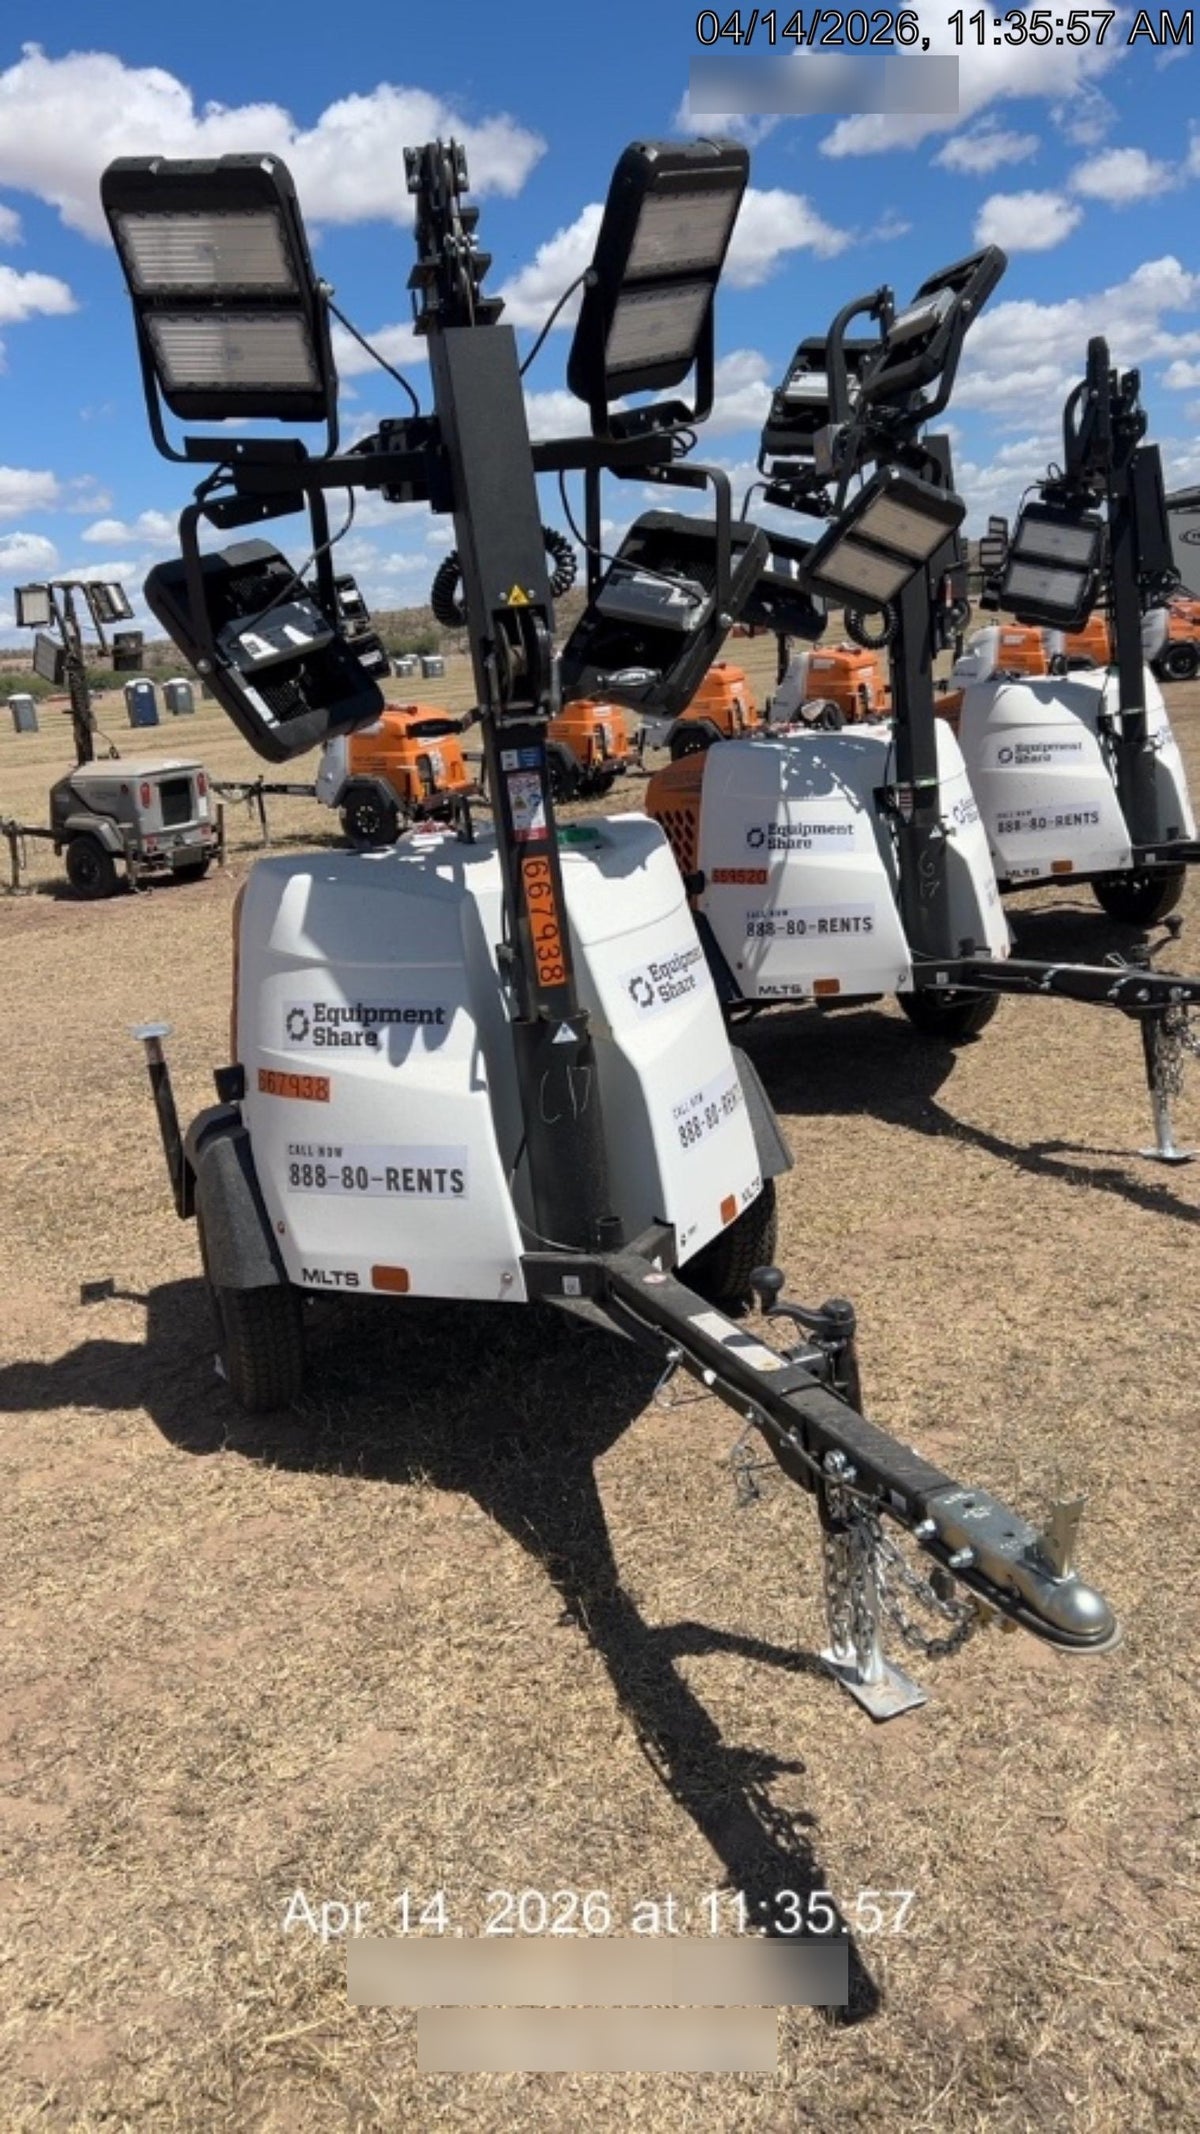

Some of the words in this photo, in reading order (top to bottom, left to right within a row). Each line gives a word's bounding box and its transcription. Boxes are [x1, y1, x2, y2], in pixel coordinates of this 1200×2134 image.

[767, 822, 855, 837] Equipment
[998, 811, 1098, 833] 888-80-RENTS
[767, 838, 812, 850] Share
[523, 861, 564, 982] 667938
[746, 917, 873, 937] 888-80-RENTS
[657, 974, 697, 1003] Share
[758, 985, 801, 996] MLTS
[312, 1002, 446, 1026] Equipment
[312, 1027, 379, 1048] Share
[288, 1144, 315, 1157] CALL
[317, 1146, 343, 1158] NOW
[289, 1163, 464, 1194] 888-80-RENTS
[302, 1268, 360, 1286] MLTS
